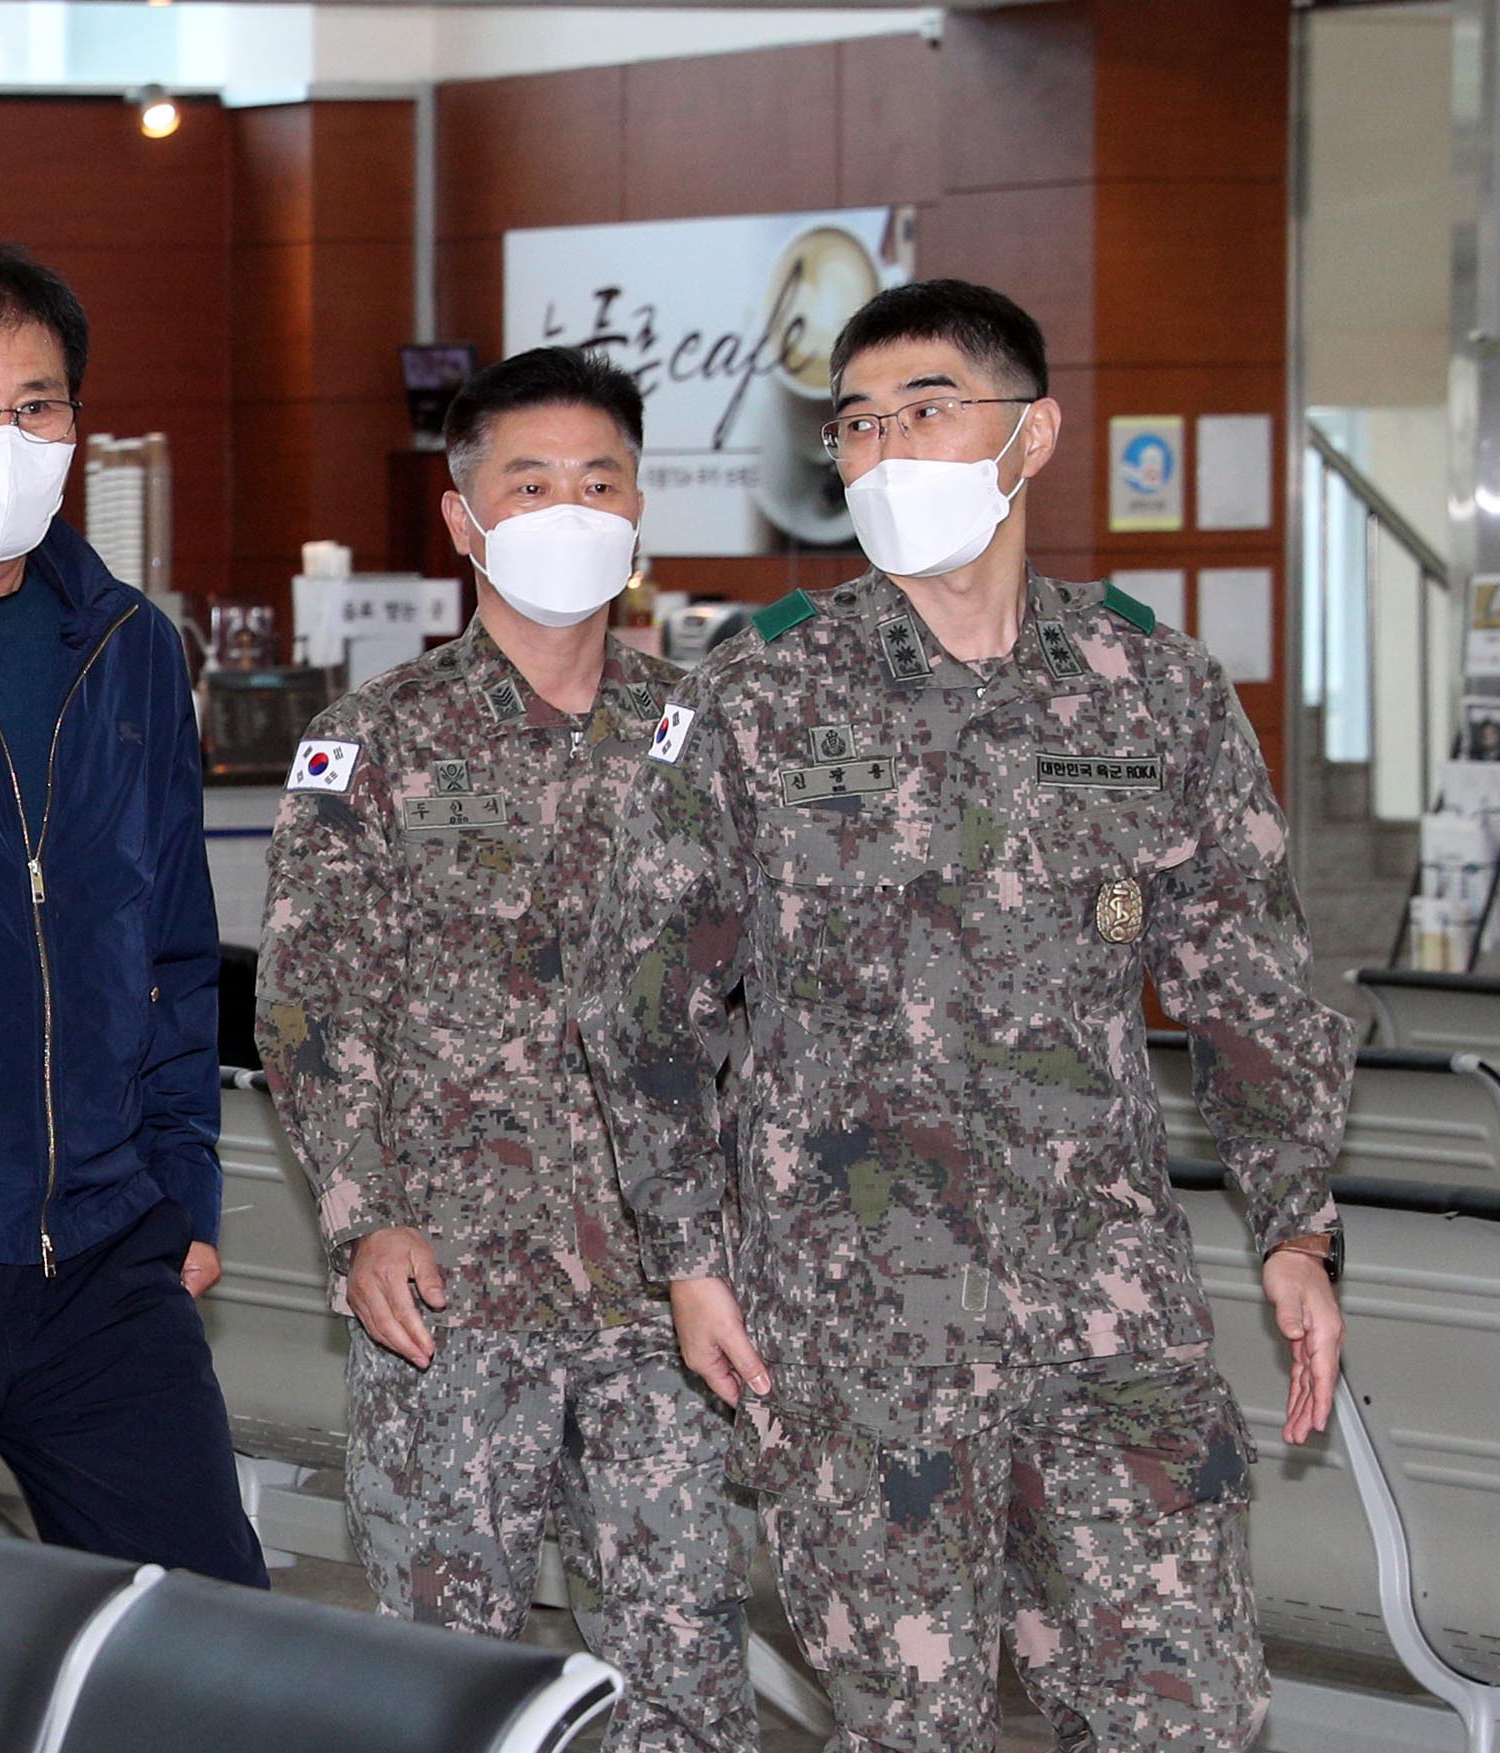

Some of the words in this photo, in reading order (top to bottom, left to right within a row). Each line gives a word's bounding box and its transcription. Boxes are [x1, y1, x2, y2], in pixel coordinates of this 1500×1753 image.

[1041, 761, 1093, 777] 대한민국
[1096, 763, 1122, 779] 육군
[1126, 764, 1158, 779] ROKA
